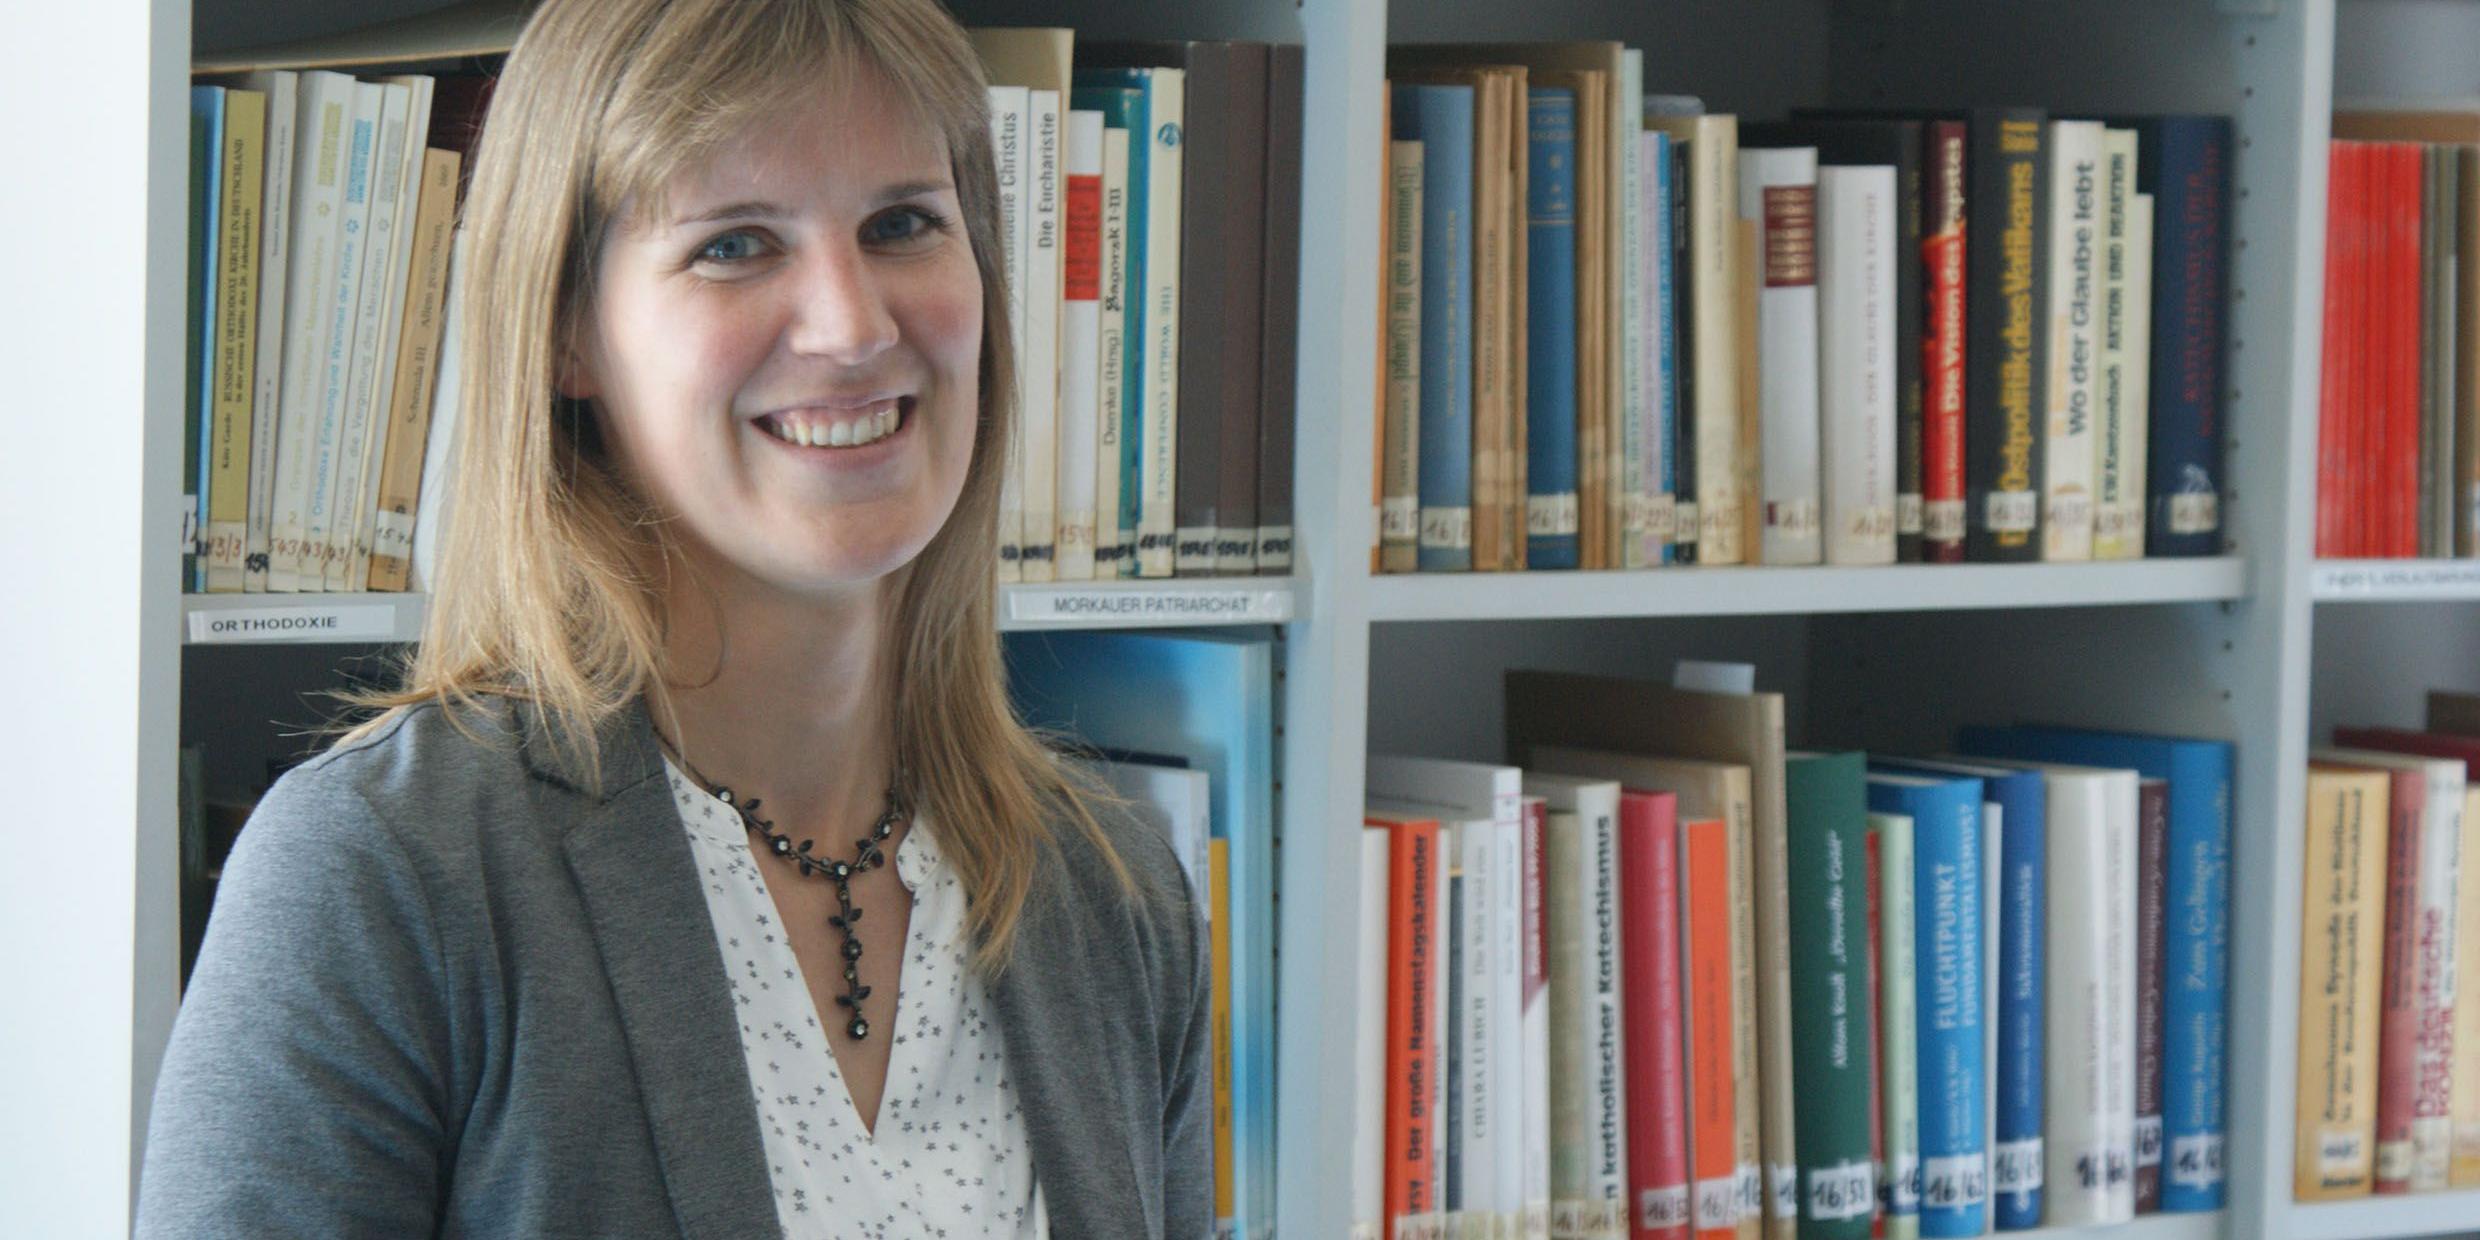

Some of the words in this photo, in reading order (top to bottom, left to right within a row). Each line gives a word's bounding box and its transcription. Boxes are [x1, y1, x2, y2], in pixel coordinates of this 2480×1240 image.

[232, 138, 244, 217] DEUTSCHLAND
[1000, 112, 1017, 187] Christus
[1038, 112, 1056, 214] Eucharistie
[2074, 161, 2095, 222] lebt
[229, 233, 241, 273] KIRCHE
[1038, 220, 1054, 249] Die
[2002, 162, 2034, 296] Vatikans
[1944, 240, 1962, 285] des
[2070, 226, 2092, 327] Glaube
[226, 278, 239, 342] ORTHODOXE
[1942, 287, 1961, 368] Vision
[1159, 322, 1171, 385] WORLD
[2070, 334, 2089, 384] der
[1941, 369, 1960, 415] Die
[2069, 389, 2087, 436] Wo
[1157, 391, 1171, 499] CONFERENCE
[312, 451, 330, 517] Orthodoxe
[211, 615, 338, 633] ORTHODOXIE
[1054, 596, 1141, 613] MORKAUER
[1144, 596, 1250, 613] PATRIARCHAT
[1596, 815, 1613, 994] Katechismus
[1959, 802, 1978, 1028] FUNDAMENTALISMUS?
[2186, 840, 2215, 937] Gelingen
[1409, 833, 1429, 1051] Namenstagskalender
[1476, 913, 1487, 947] Welt
[1935, 863, 1958, 1030] FLUCHTPUNKT
[1475, 950, 1487, 978] Die
[2417, 907, 2443, 1054] deutsche
[1409, 1057, 1426, 1120] große
[1473, 1069, 1488, 1139] CHIARA
[1600, 1003, 1618, 1176] katholischer
[2141, 1052, 2158, 1117] Church
[1407, 1126, 1424, 1162] Der
